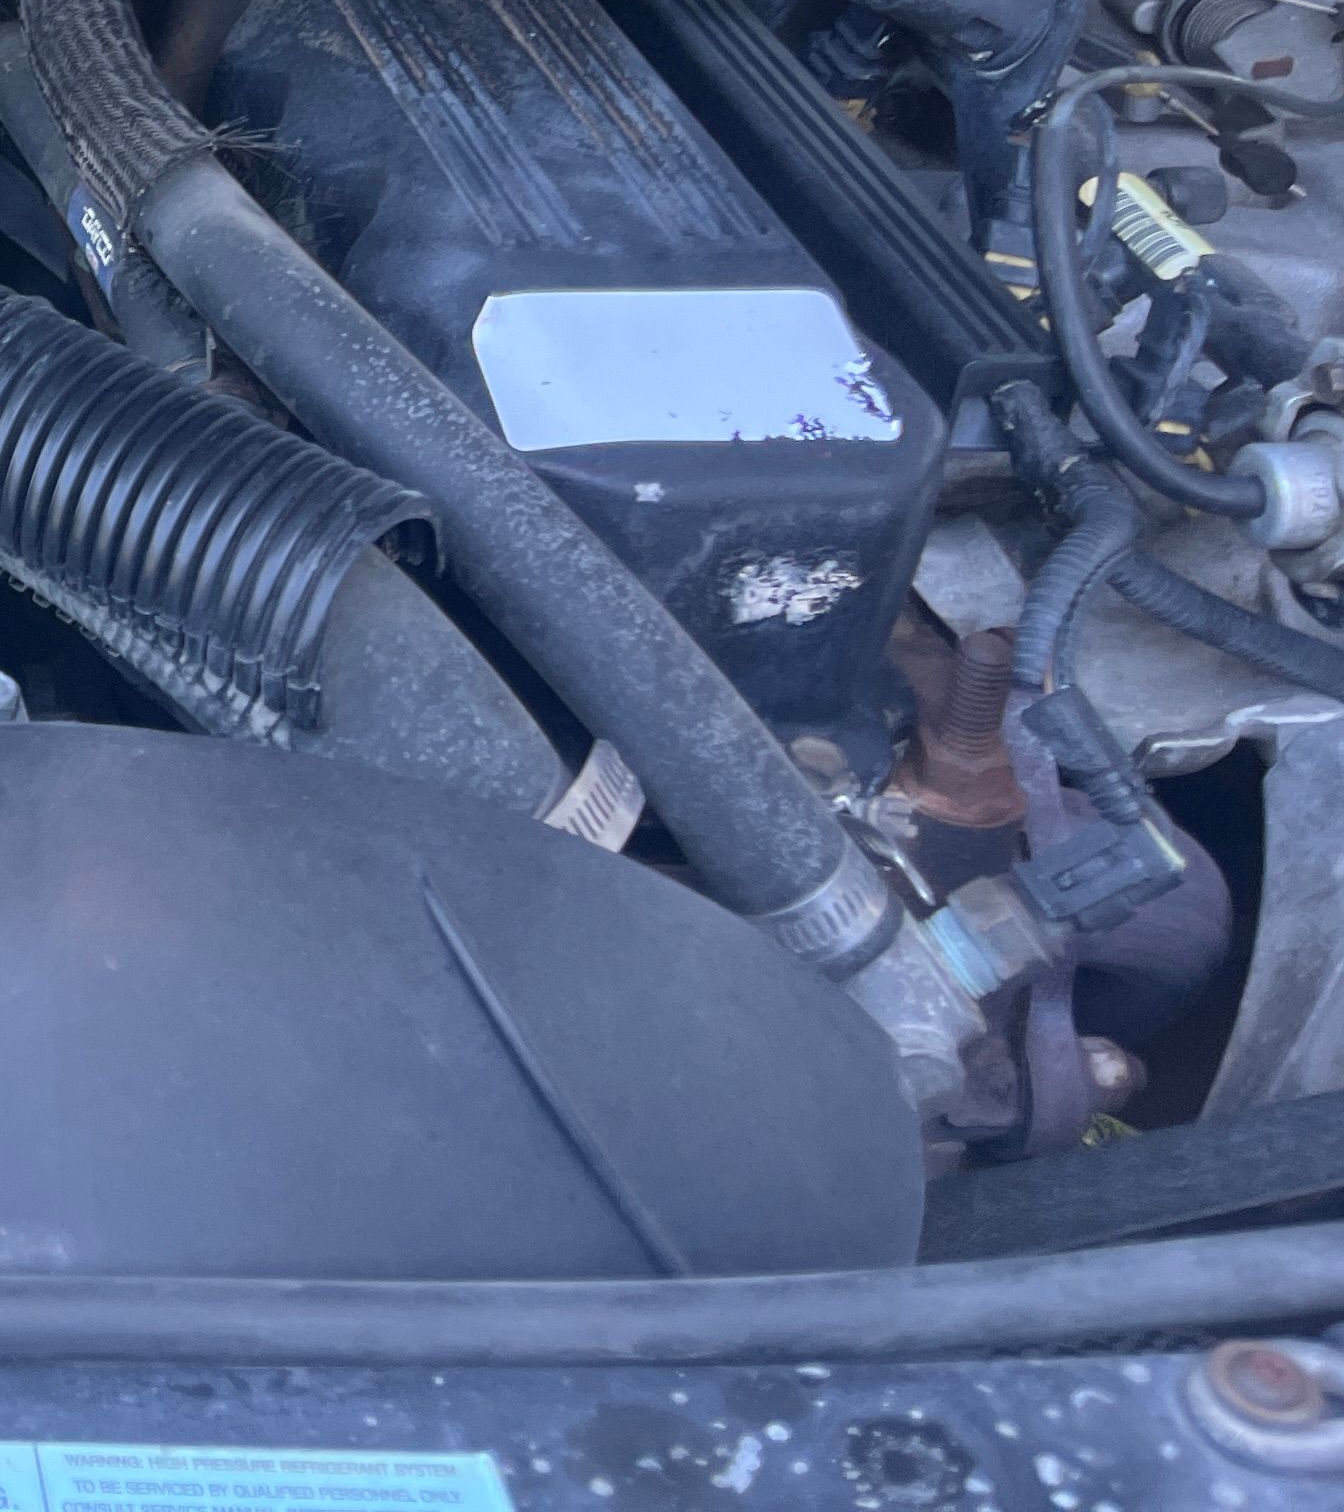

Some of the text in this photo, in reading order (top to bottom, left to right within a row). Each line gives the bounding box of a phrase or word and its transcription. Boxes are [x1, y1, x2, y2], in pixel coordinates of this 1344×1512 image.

[64, 1454, 458, 1479] WARNING: HIGH PRESSURE REFRIGERANT SYSTEM
[73, 1479, 96, 1495] TO
[99, 1479, 123, 1496] BE
[125, 1480, 205, 1498] SERVICED
[209, 1481, 232, 1499] BY
[234, 1483, 315, 1502] QUALIFIED
[318, 1485, 417, 1504] PERSONNEL
